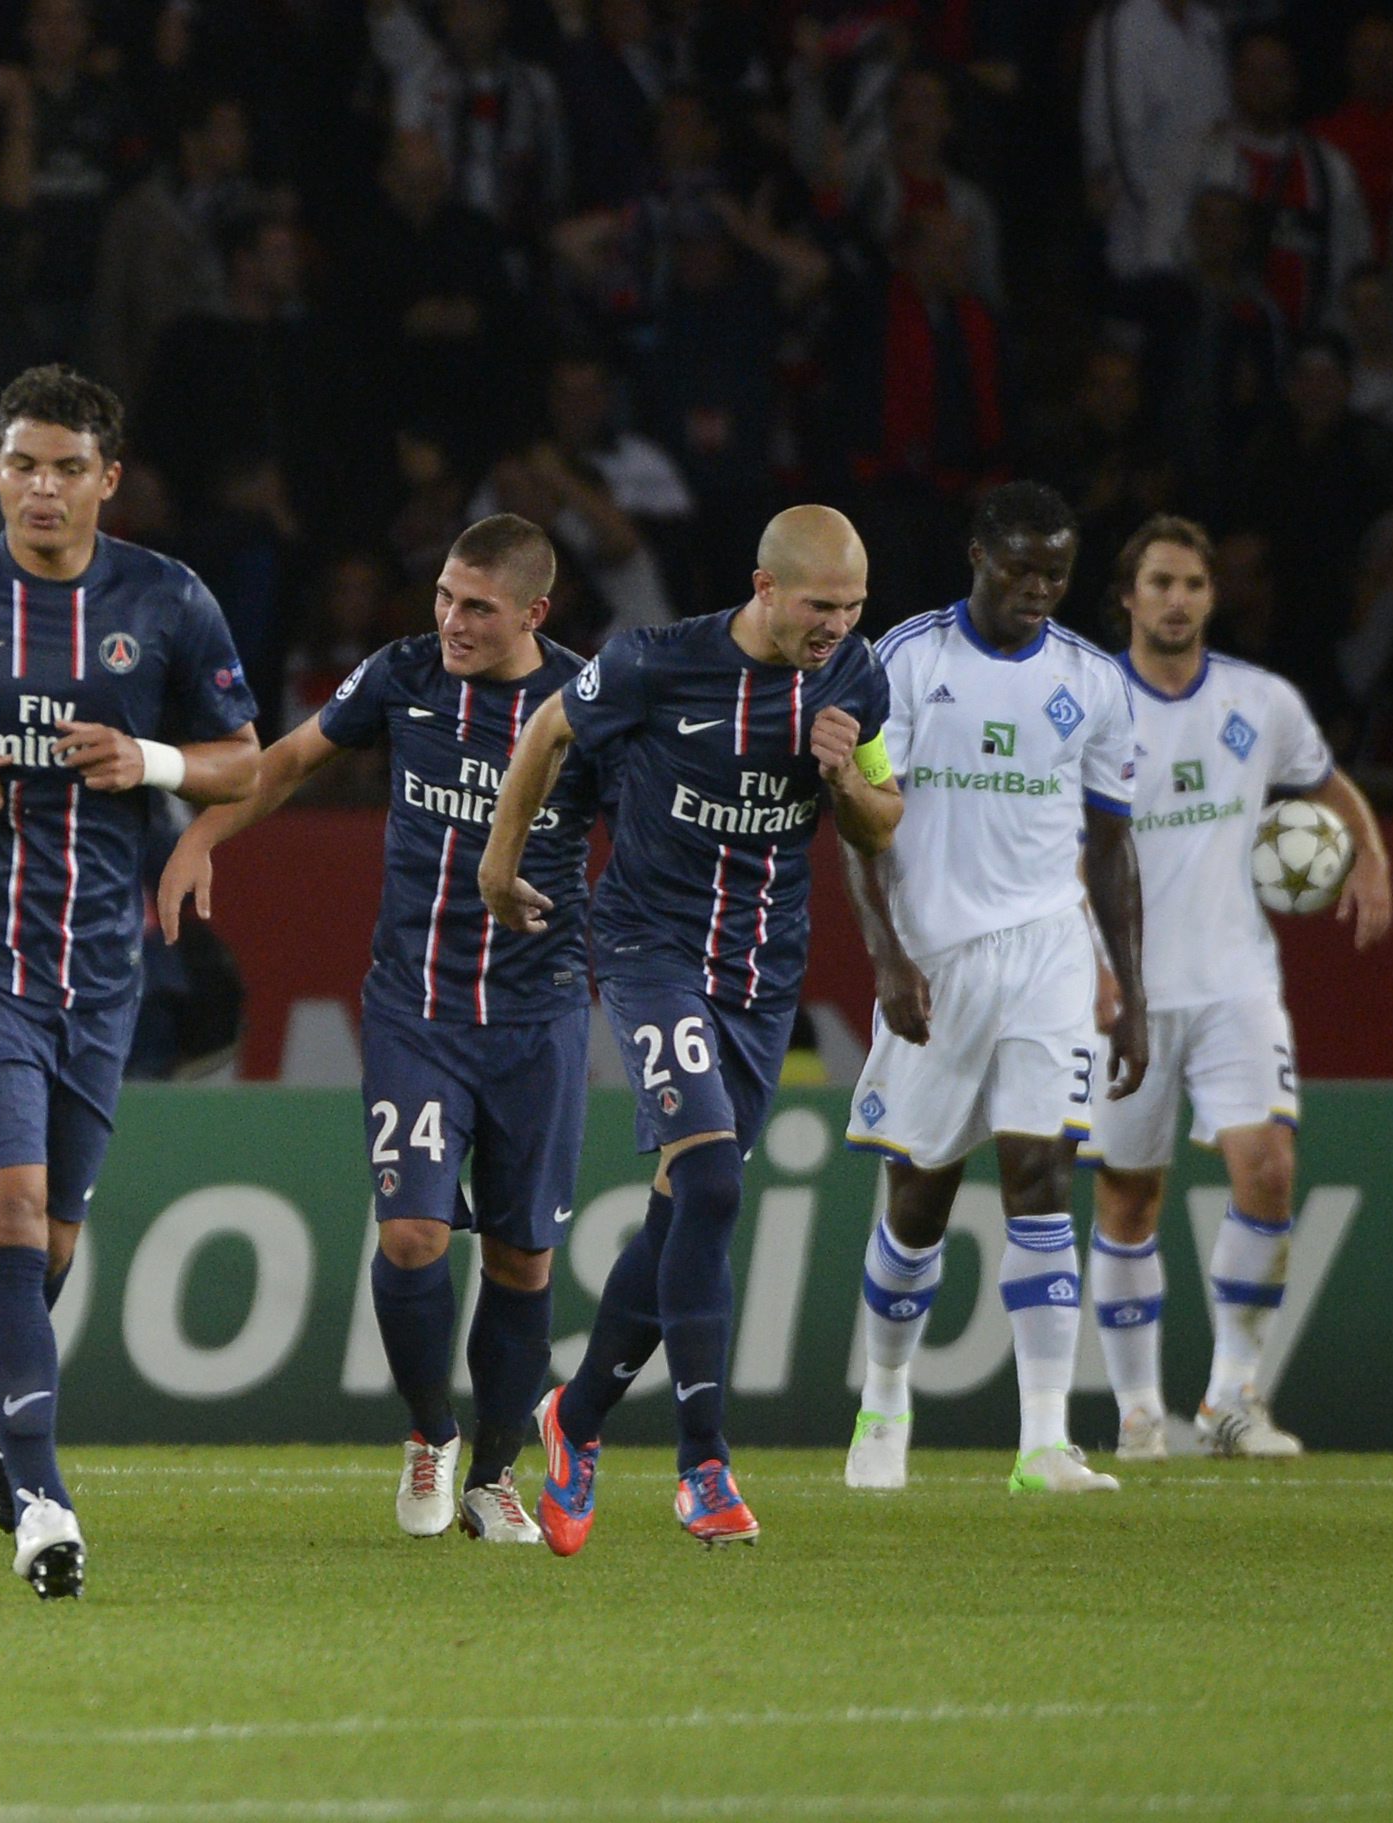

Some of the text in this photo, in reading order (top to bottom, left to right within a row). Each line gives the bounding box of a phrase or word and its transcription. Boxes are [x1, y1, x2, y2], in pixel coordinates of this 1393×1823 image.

[670, 783, 817, 834] Emirate
[739, 771, 789, 801] Fly
[913, 766, 1063, 797] PrivatBak
[634, 1016, 710, 1090] 26
[1069, 1047, 1097, 1105] 3
[370, 1100, 446, 1163] 24
